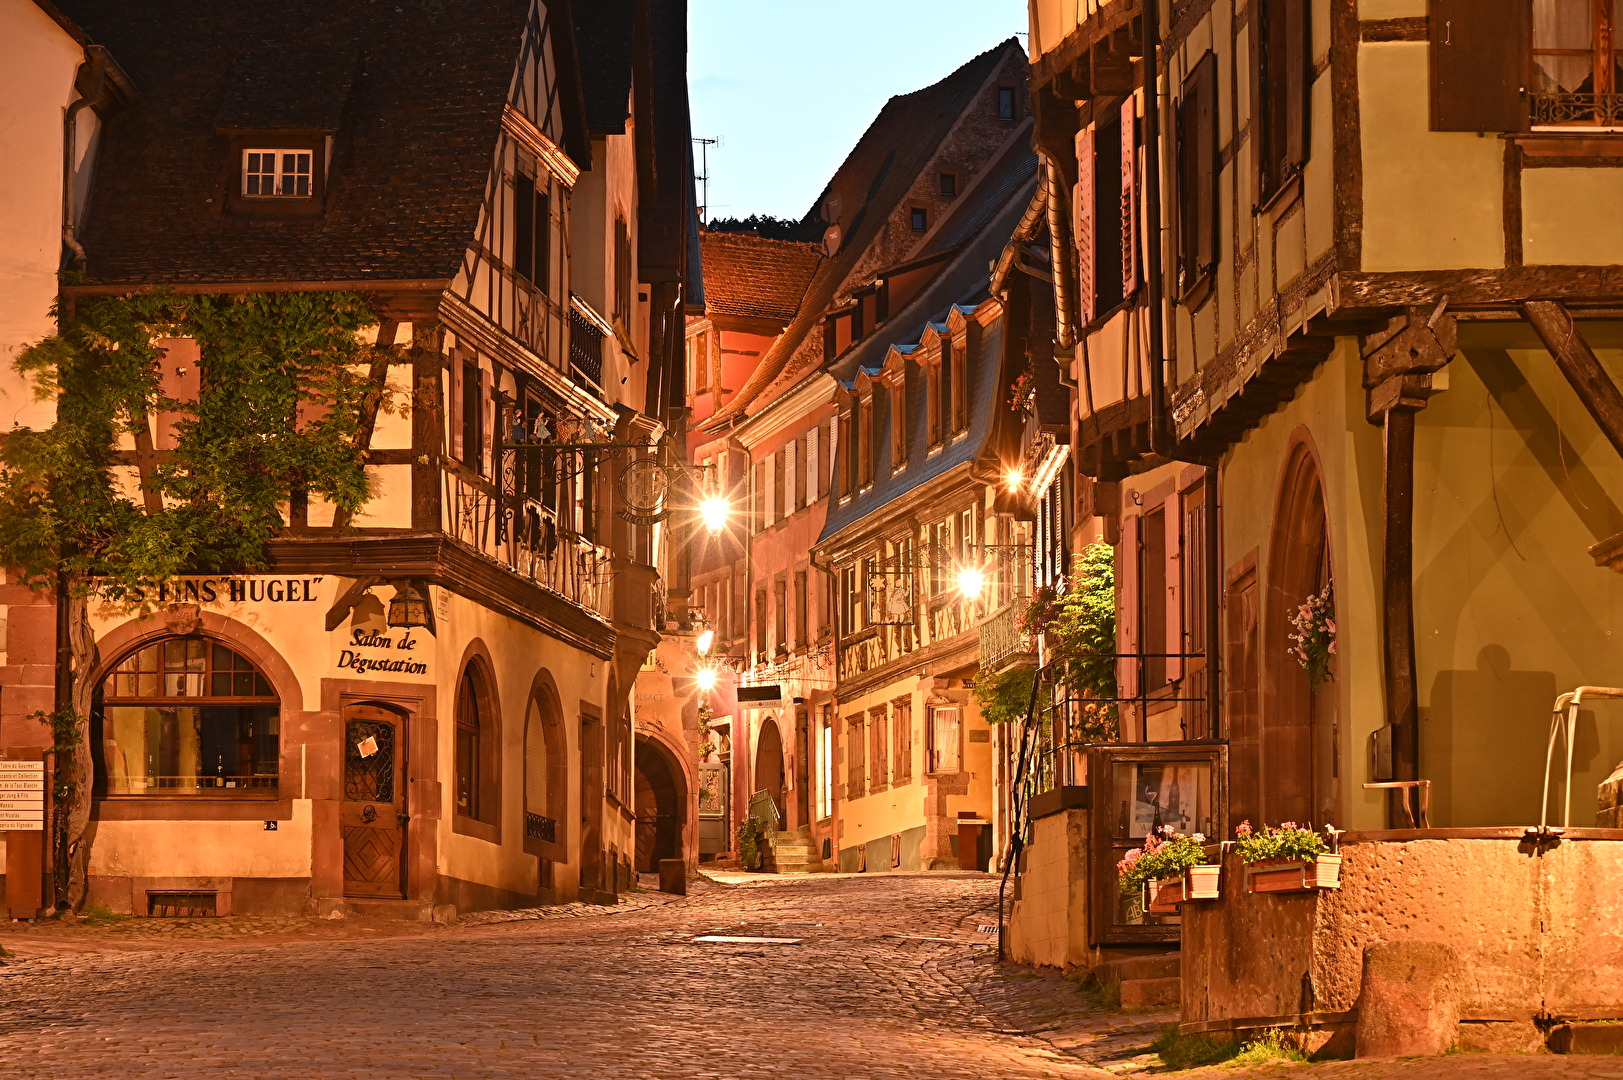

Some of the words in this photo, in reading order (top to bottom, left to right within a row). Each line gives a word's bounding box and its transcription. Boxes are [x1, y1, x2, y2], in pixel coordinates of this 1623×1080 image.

[622, 512, 653, 525] HUGEL
[158, 579, 217, 602] FINS
[220, 577, 324, 603] "HUGEL"
[349, 628, 392, 648] Salon
[397, 632, 417, 650] de
[337, 650, 427, 675] Dégustation
[1126, 904, 1143, 922] AB
